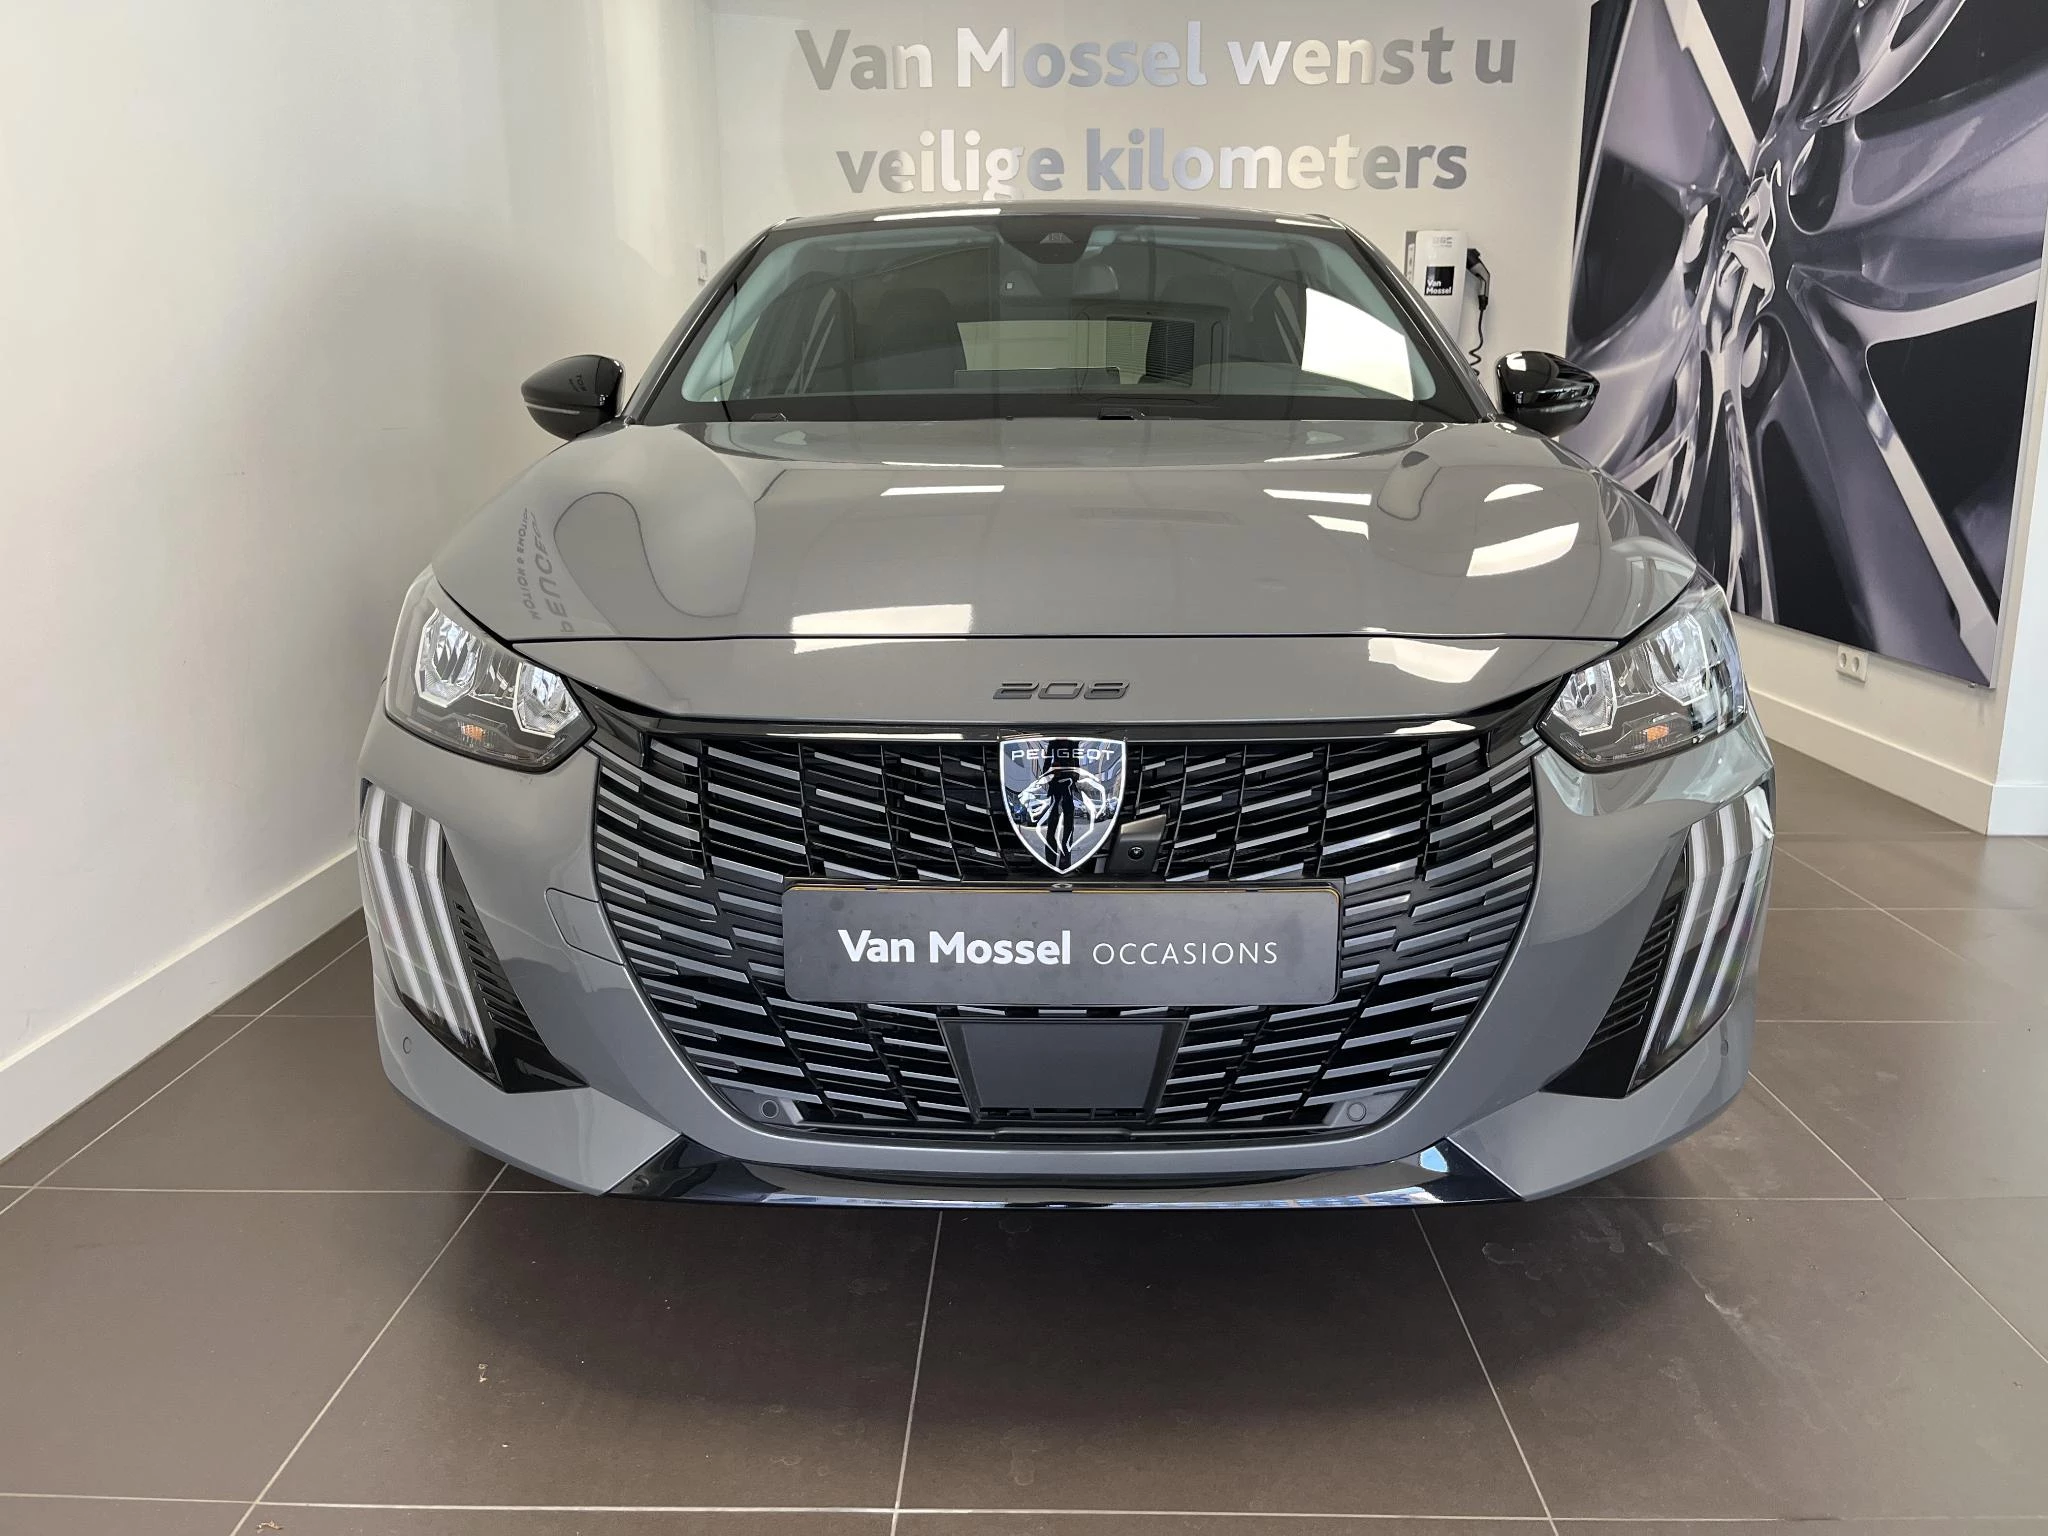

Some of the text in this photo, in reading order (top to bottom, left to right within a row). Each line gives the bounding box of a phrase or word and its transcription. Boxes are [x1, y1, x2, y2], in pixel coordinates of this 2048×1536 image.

[795, 21, 1516, 89] Van Mossel wenst u
[836, 128, 1468, 201] veilige kilometers
[1426, 286, 1452, 294] Mossel
[993, 681, 1130, 700] 208
[1011, 748, 1114, 761] PEUGEOT
[838, 929, 1278, 965] Van Mossel OCCASIONS
